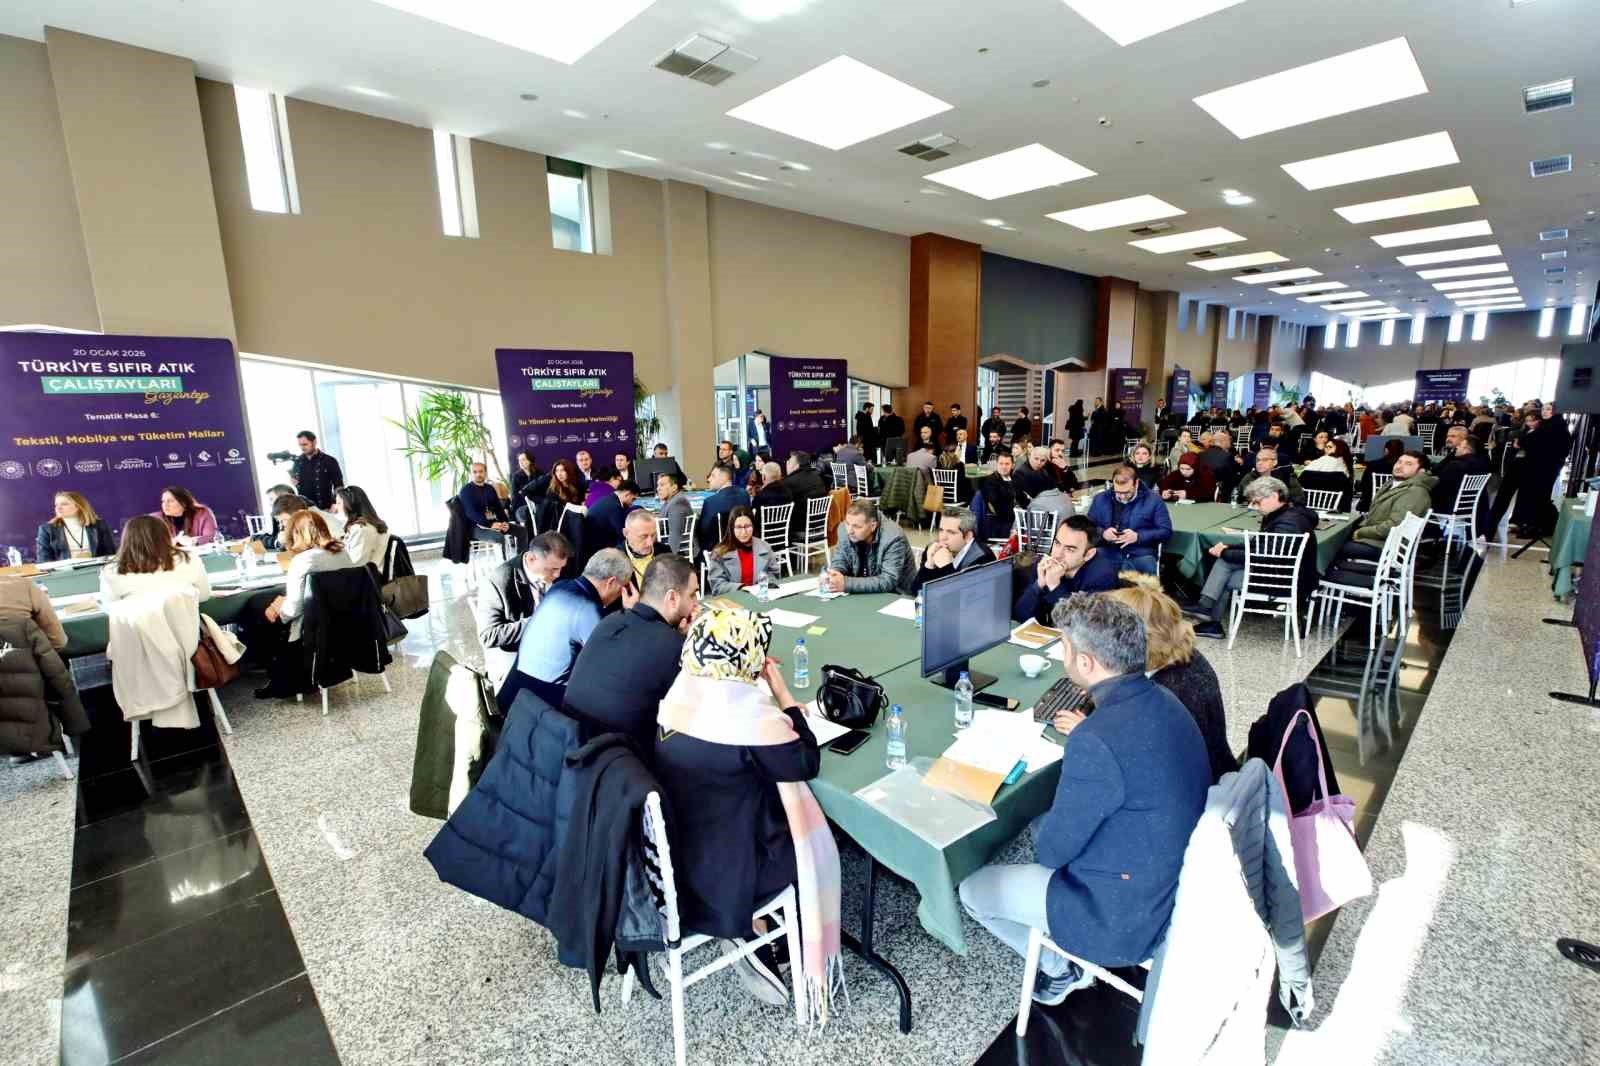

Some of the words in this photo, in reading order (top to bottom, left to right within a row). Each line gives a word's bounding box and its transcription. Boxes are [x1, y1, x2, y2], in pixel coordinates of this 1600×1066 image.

[73, 348, 87, 356] 20
[89, 349, 119, 357] OCAK
[17, 359, 103, 373] TÜRKİYE
[108, 362, 152, 373] SIFIR
[158, 362, 195, 373] ATIK
[520, 366, 561, 376] TÜRKİYE
[563, 368, 586, 376] SIFIR
[588, 368, 607, 376] ATIK
[48, 379, 177, 391] ÇALIŞTAYLARI
[84, 413, 123, 421] Tematik
[125, 412, 149, 420] Masa
[13, 435, 63, 446] Tekstil,
[66, 434, 118, 444] Mobilya
[121, 434, 135, 442] ve
[138, 431, 185, 441] Tüketim
[189, 430, 225, 439] Malları
